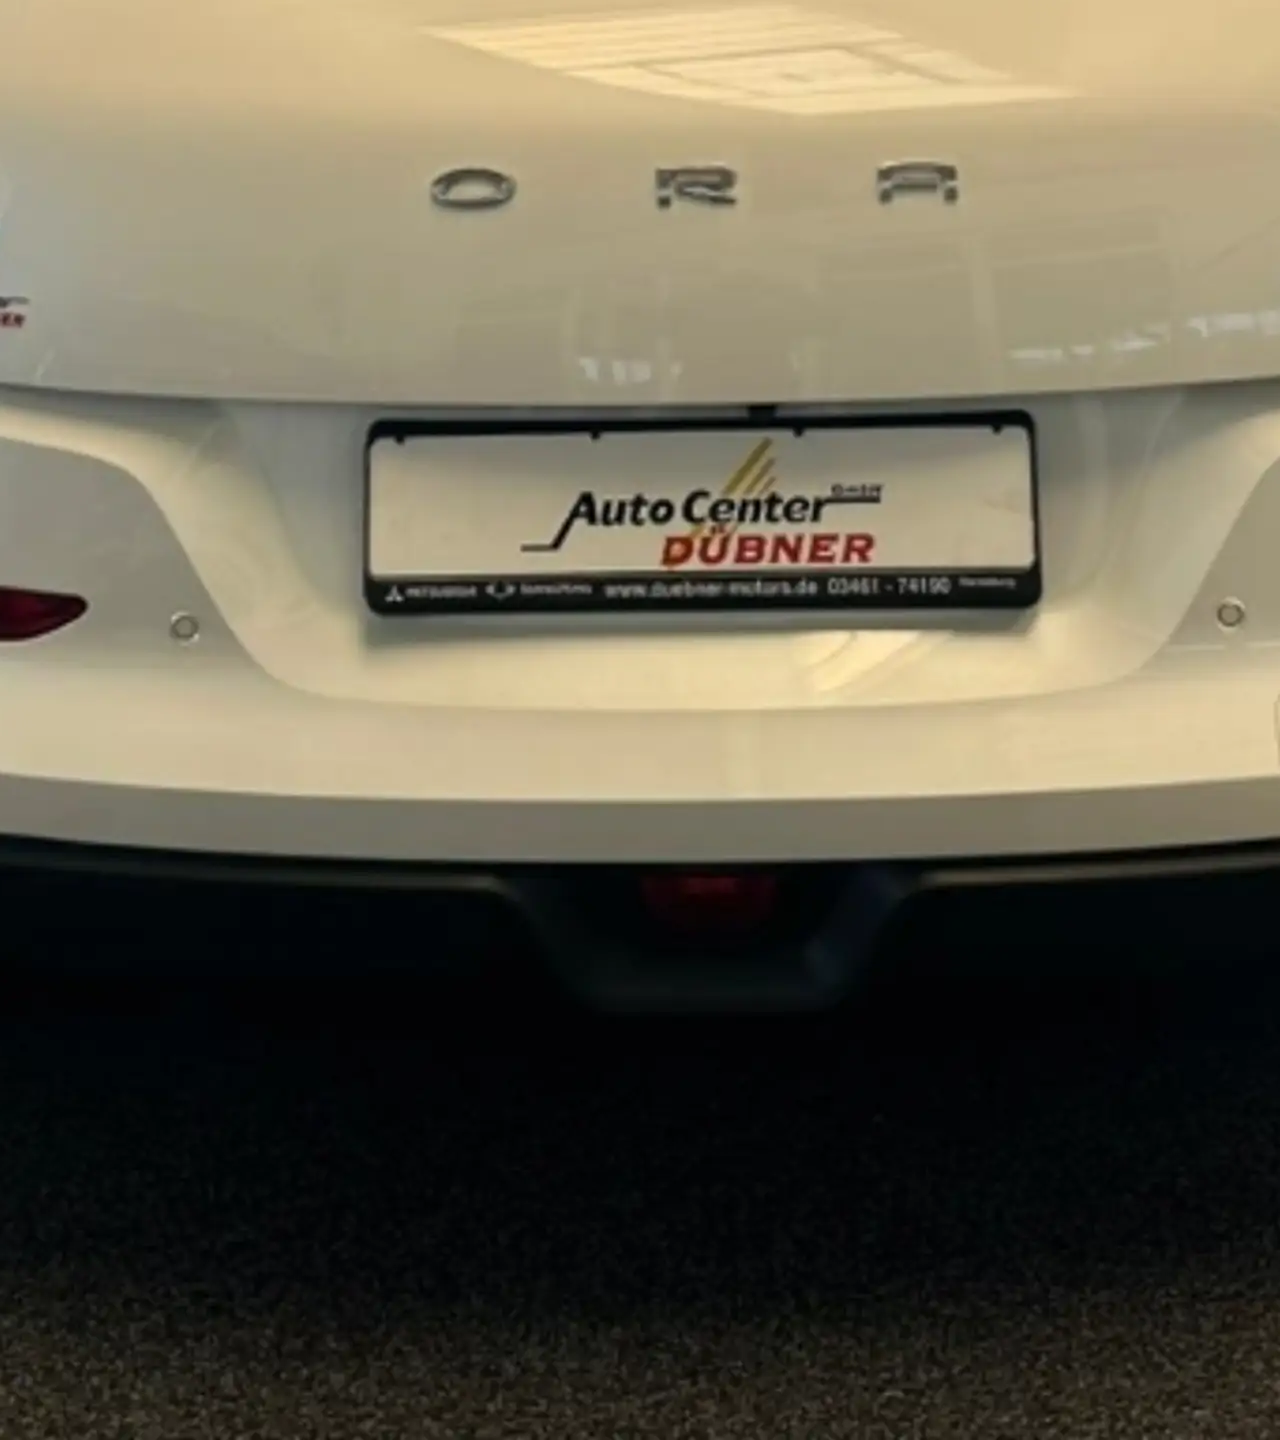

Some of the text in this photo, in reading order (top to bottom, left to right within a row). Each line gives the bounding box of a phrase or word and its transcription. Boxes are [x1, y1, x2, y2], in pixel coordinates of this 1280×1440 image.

[571, 491, 674, 526] Auto
[682, 489, 826, 524] Center
[660, 526, 875, 568] DÜBNER
